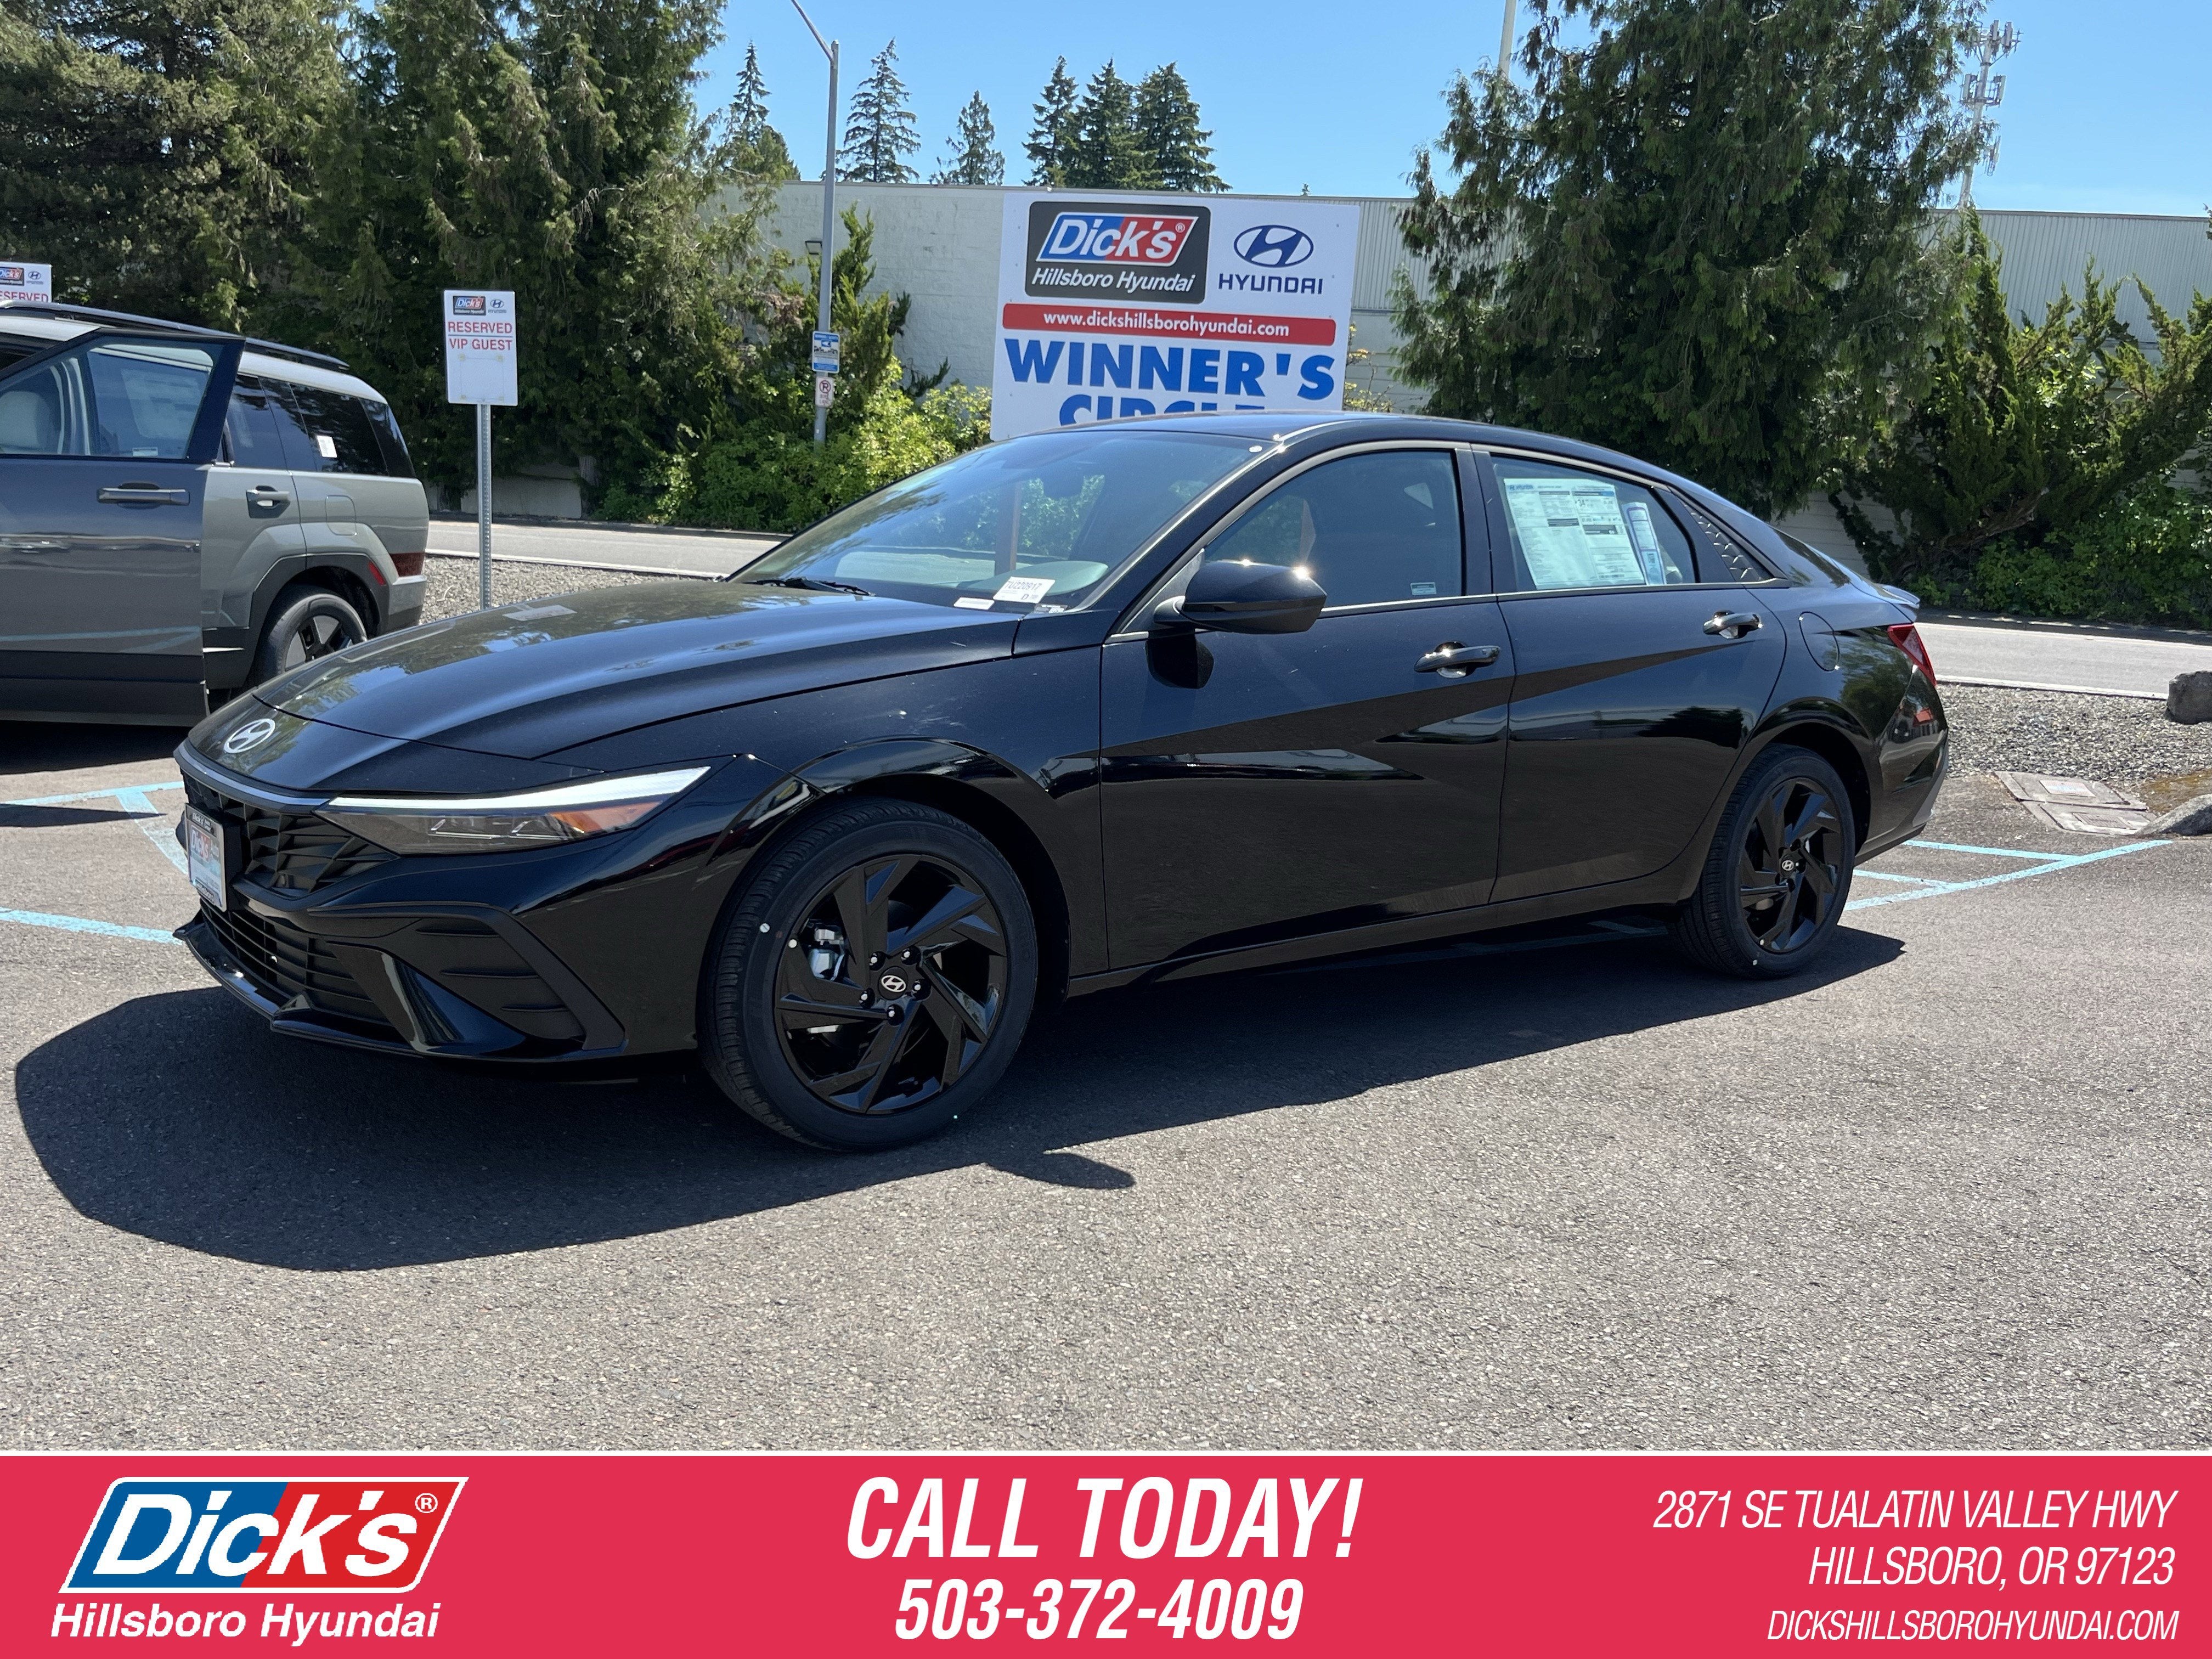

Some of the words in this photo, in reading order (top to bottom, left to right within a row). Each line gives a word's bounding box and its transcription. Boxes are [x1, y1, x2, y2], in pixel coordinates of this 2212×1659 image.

[1049, 219, 1177, 259] Dick's
[1032, 268, 1114, 287] Hillsboro
[1116, 271, 1196, 294] Hyundai
[1218, 273, 1323, 295] HYUNDAI
[448, 321, 512, 334] RESERVED
[1043, 311, 1290, 337] www.dickshillsborohyundai.com
[449, 338, 468, 349] VIP
[472, 339, 513, 351] GUEST
[1004, 338, 1335, 401] WINNER'S
